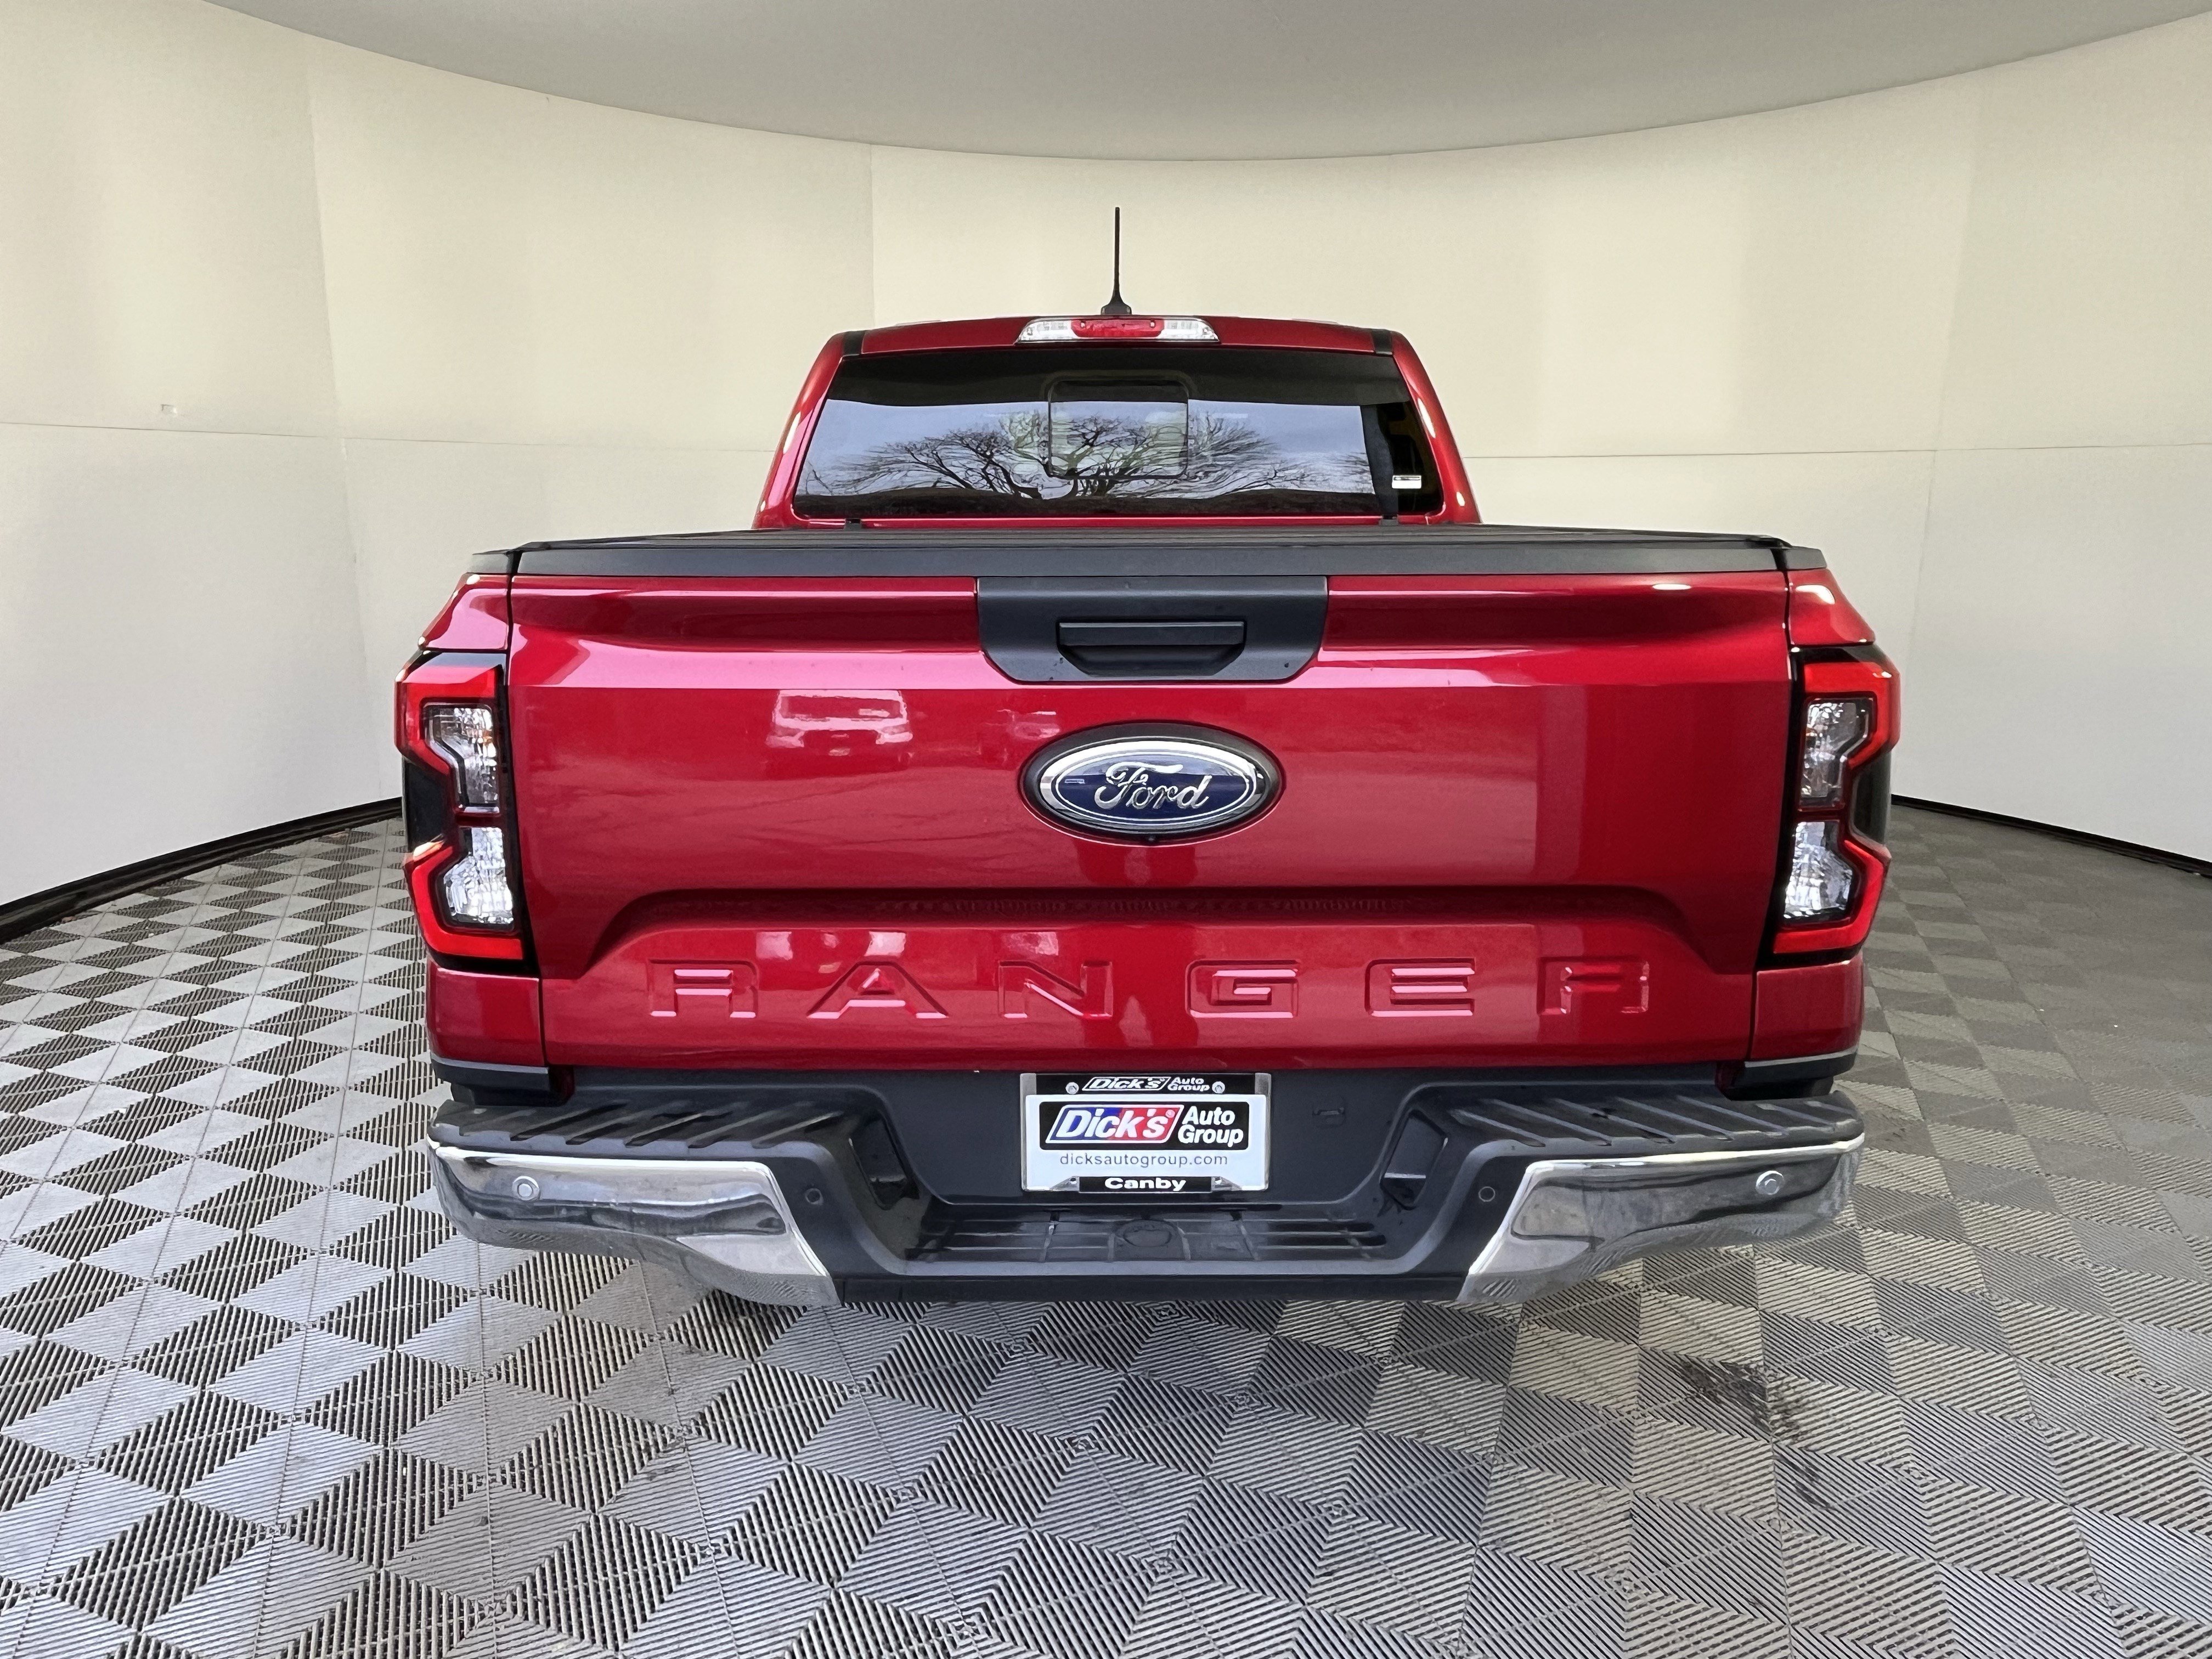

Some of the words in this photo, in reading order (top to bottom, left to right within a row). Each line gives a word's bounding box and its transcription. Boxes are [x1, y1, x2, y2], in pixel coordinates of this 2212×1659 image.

[1094, 761, 1212, 809] Ford
[647, 957, 1649, 1019] RANGER
[1088, 1077, 1162, 1089] Dick's
[1167, 1083, 1210, 1092] Group
[1056, 1108, 1169, 1139] Dick's
[1181, 1105, 1235, 1125] Auto
[1177, 1124, 1244, 1148] Group
[1059, 1153, 1228, 1168] dicksautogroup.com
[1104, 1177, 1187, 1192] Canby
